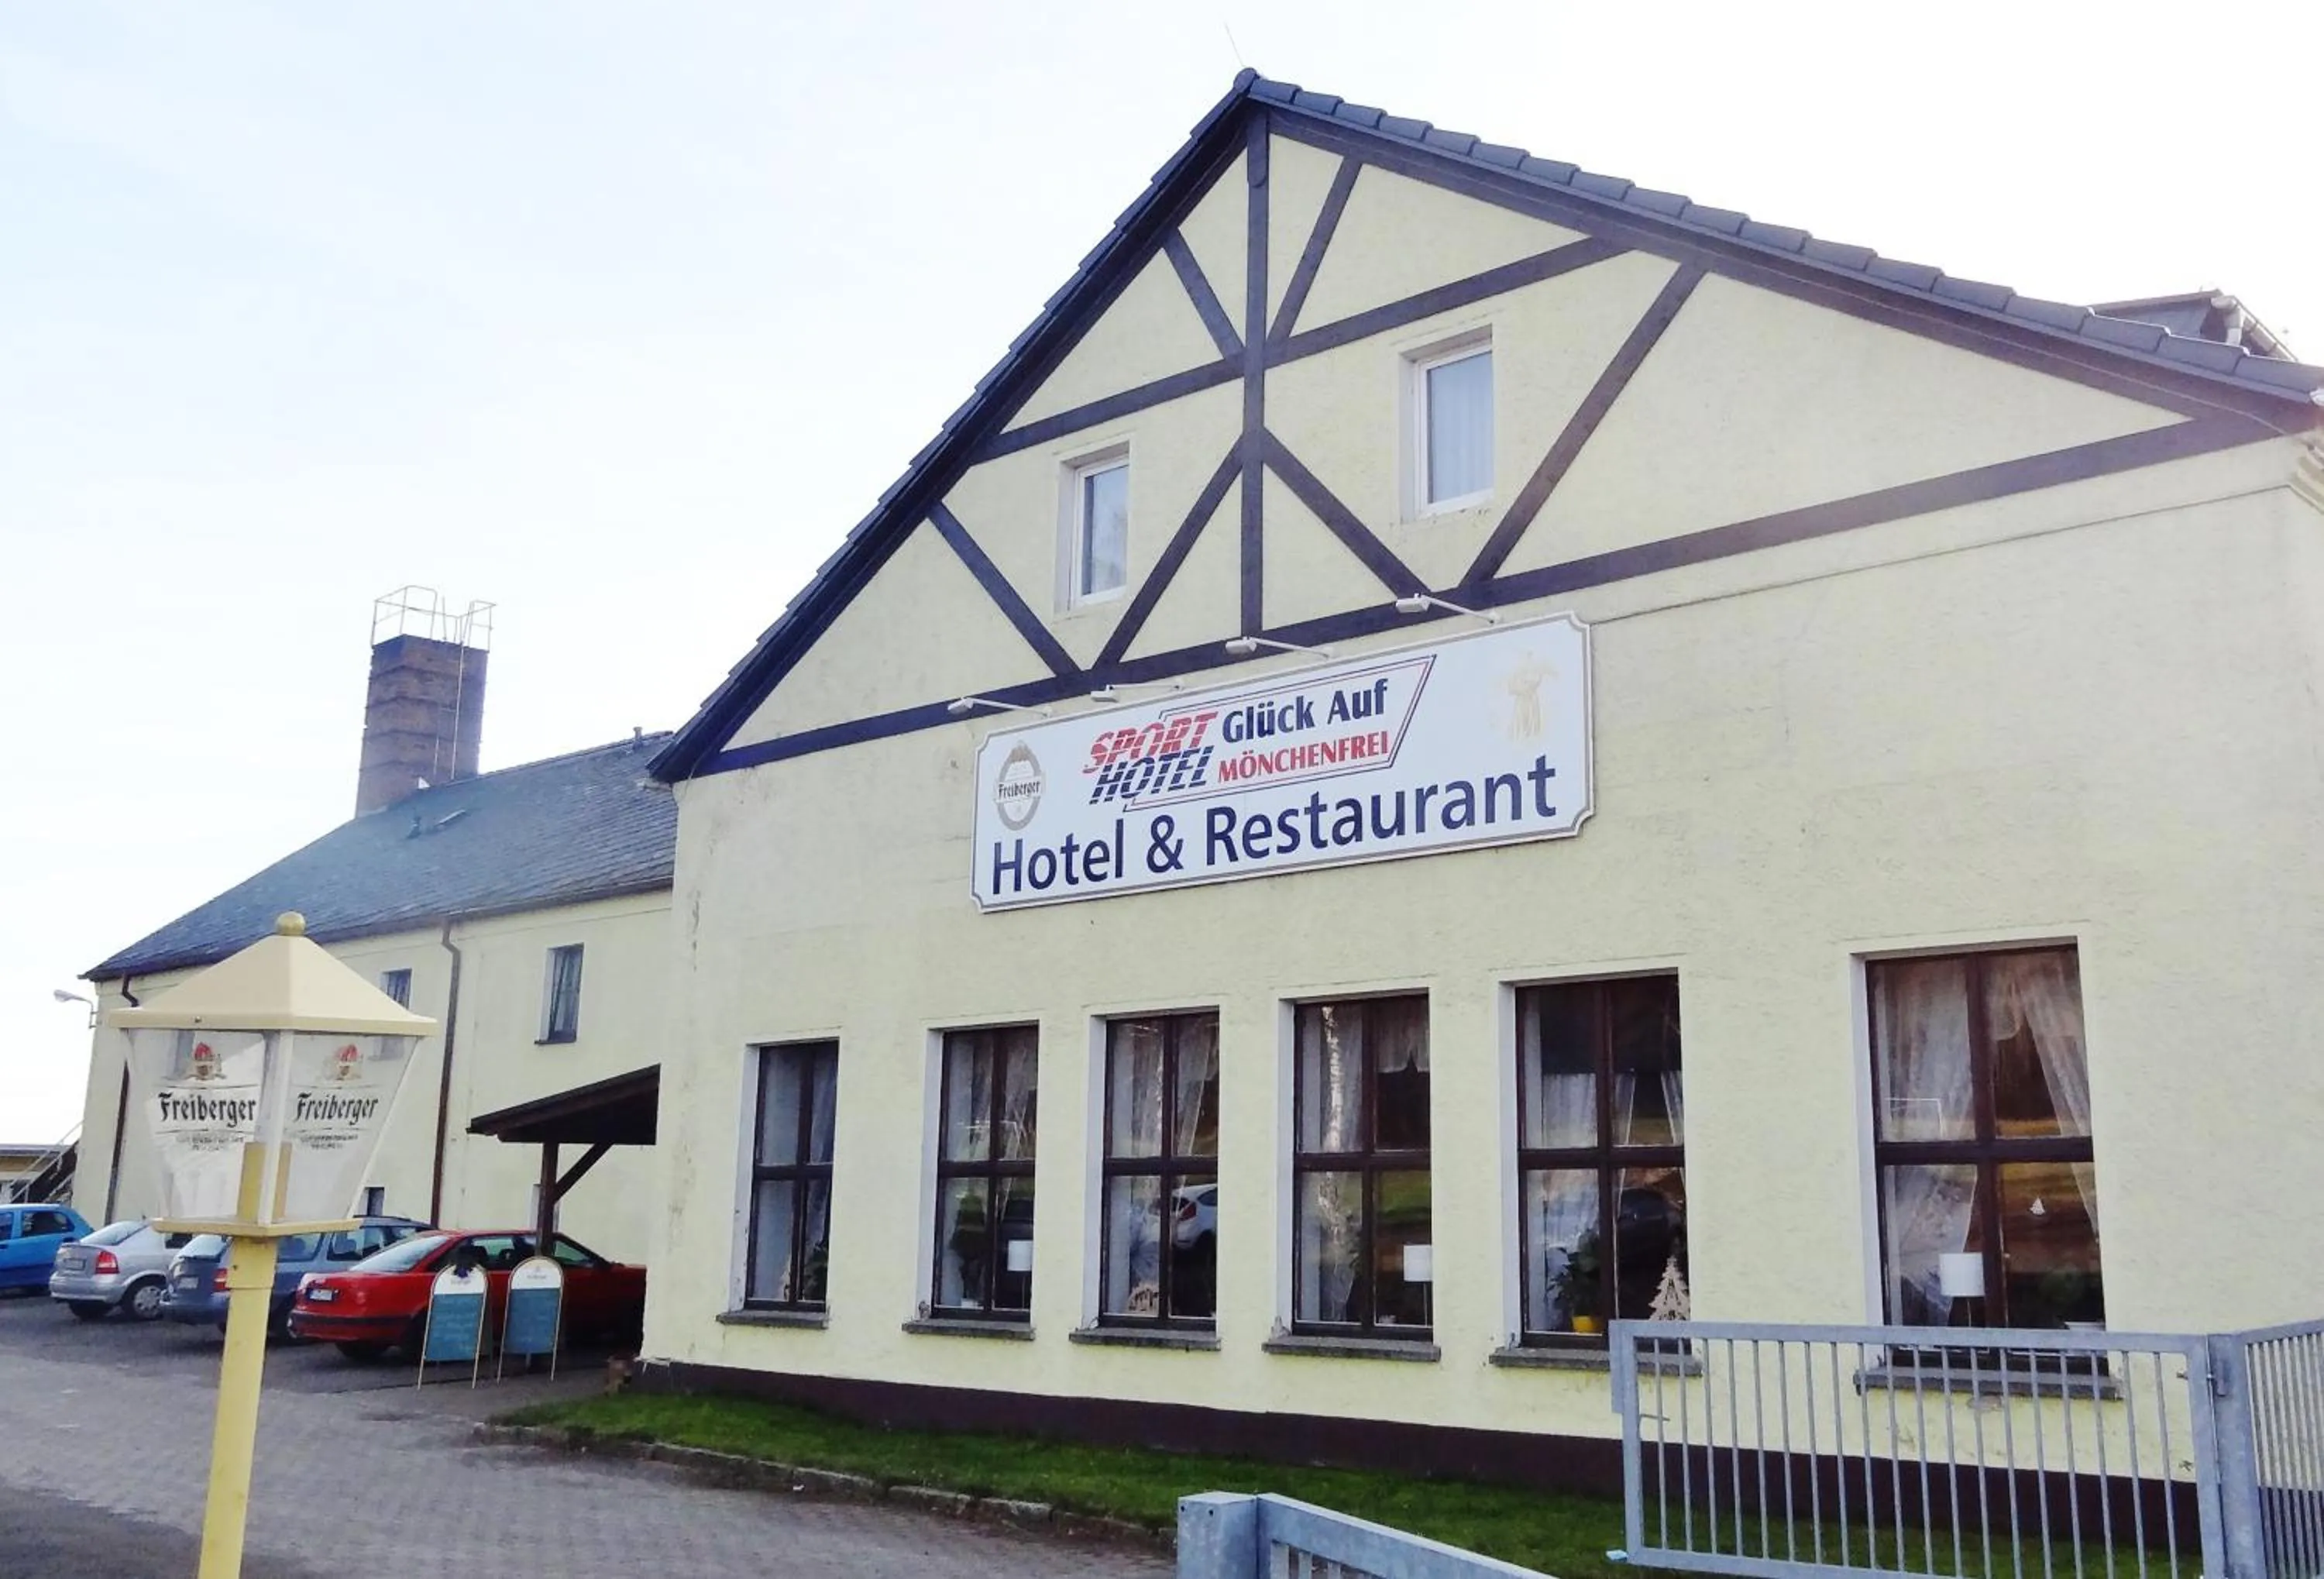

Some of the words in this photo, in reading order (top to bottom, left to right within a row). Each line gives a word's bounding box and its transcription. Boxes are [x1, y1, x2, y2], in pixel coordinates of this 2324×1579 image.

[1222, 696, 1315, 743] Glück
[1328, 679, 1388, 724] Auf
[1083, 711, 1219, 774] SPORT
[1219, 731, 1388, 783] MÖNCHENFREI
[997, 781, 1040, 799] Freiberger
[1089, 745, 1215, 804] HOTEL
[992, 818, 1124, 894] Hotel
[1147, 814, 1184, 873] &
[1206, 755, 1556, 865] Restaurant
[158, 1092, 256, 1127] Freiberger
[294, 1092, 379, 1125] Freiberger
